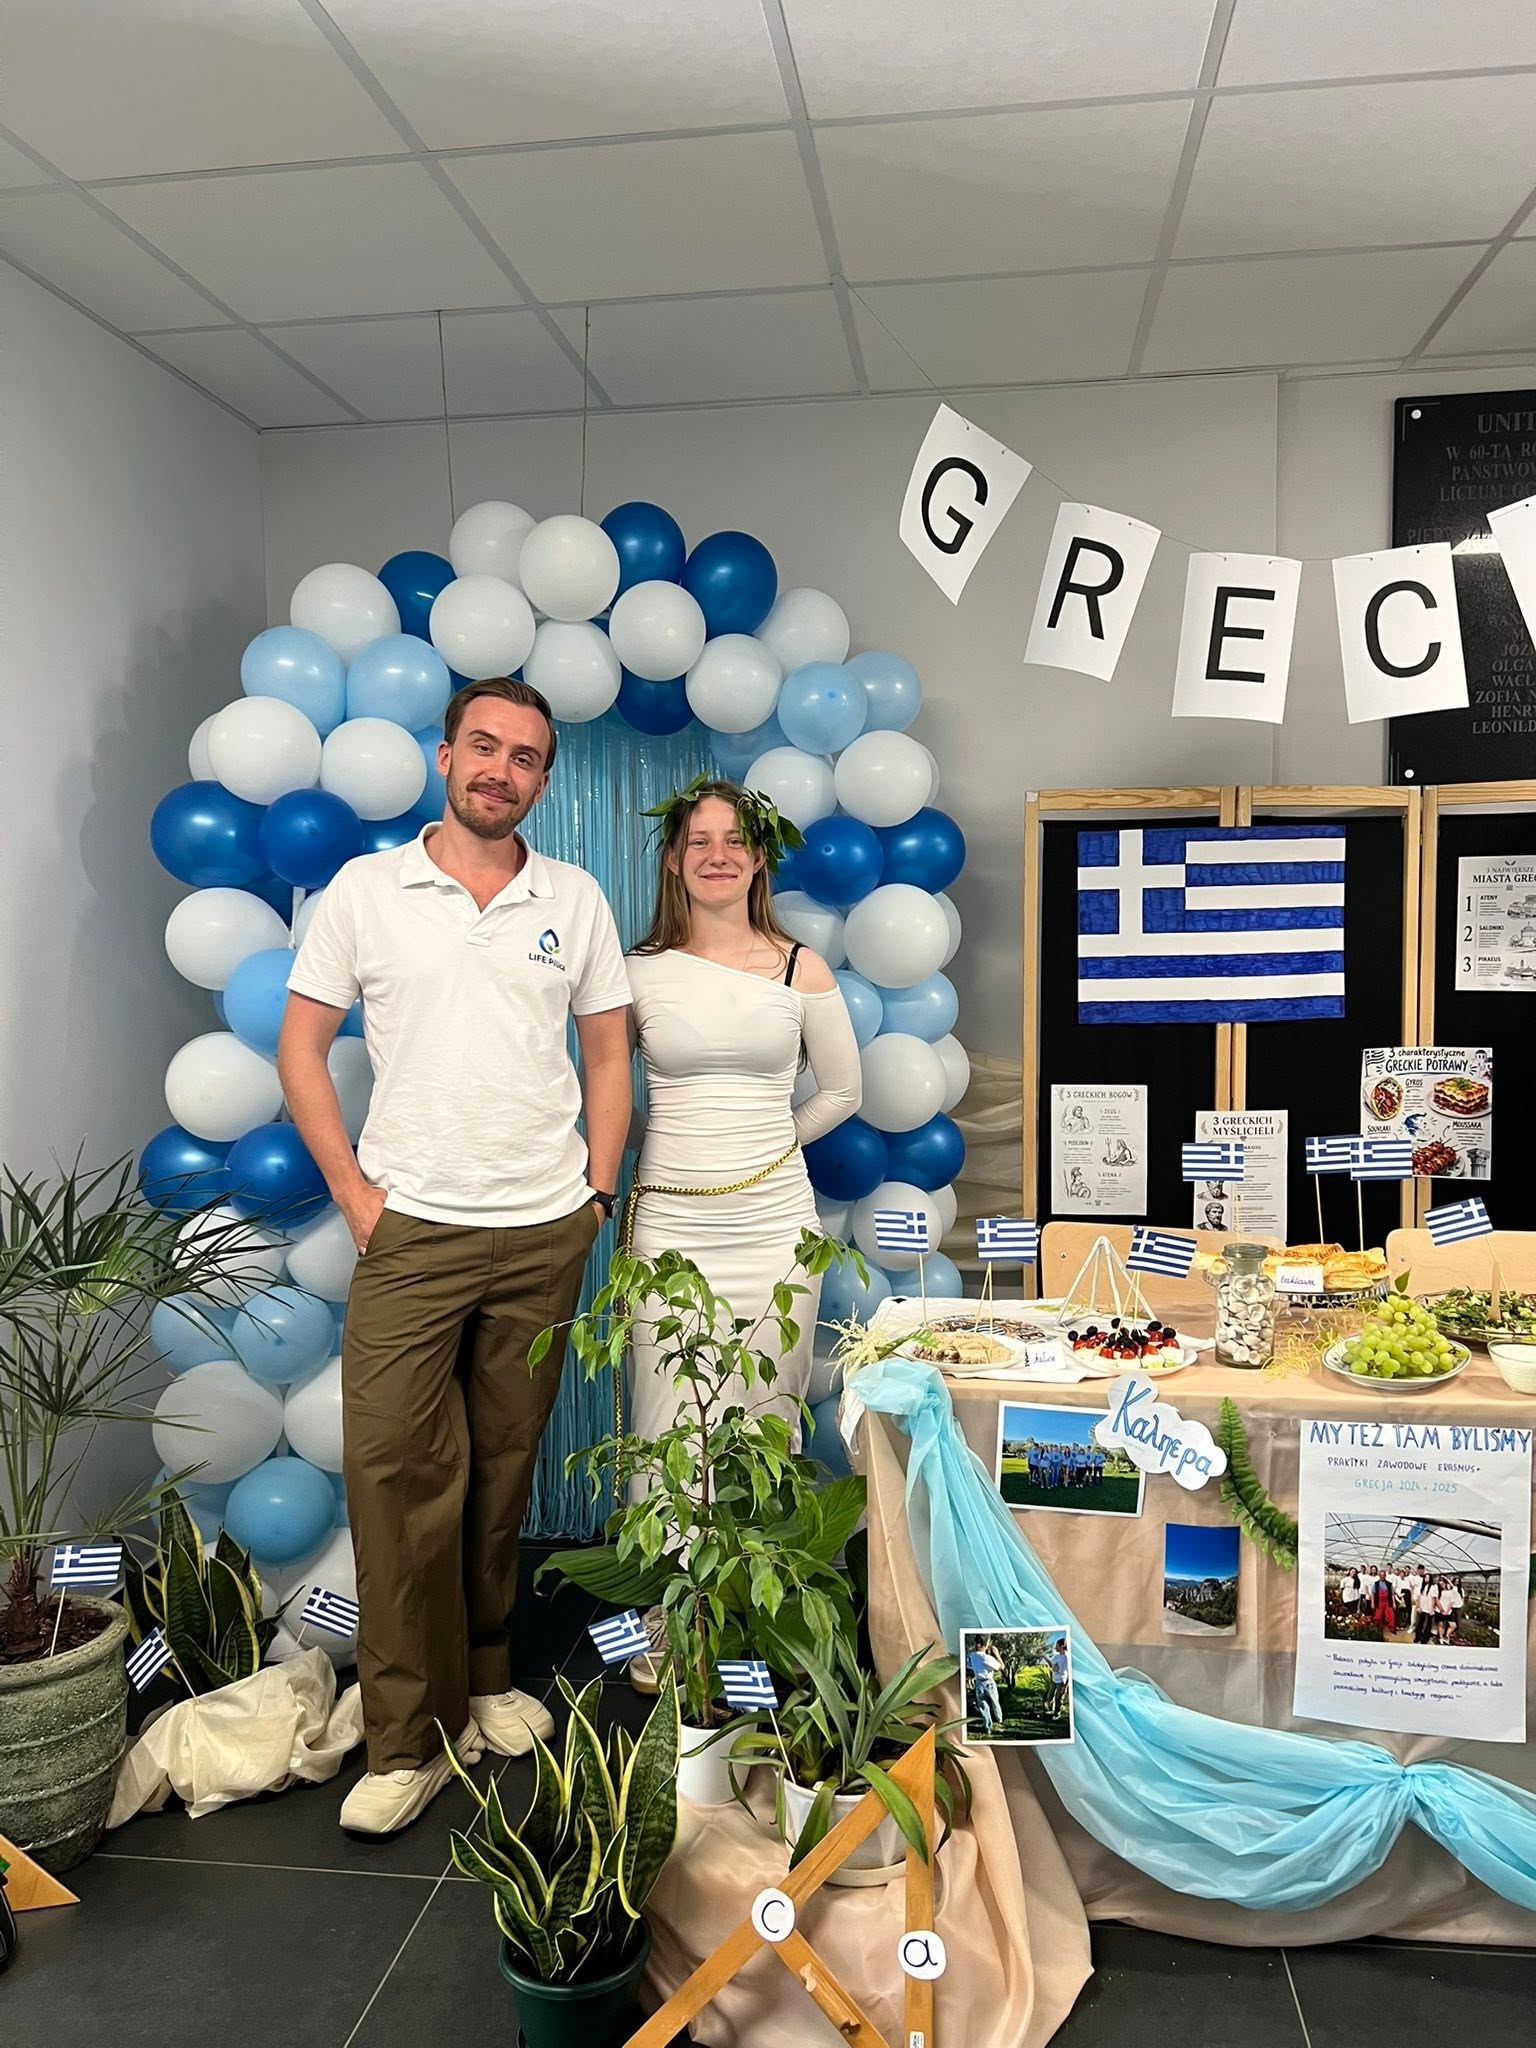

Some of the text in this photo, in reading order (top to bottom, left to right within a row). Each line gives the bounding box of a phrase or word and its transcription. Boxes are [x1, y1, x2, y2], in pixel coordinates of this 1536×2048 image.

[1492, 659, 1535, 672] OLGA
[1475, 690, 1521, 703] ZOFIA
[1473, 874, 1536, 883] MIASTA GRE
[1466, 895, 1472, 912] 1
[1463, 925, 1473, 942] 2
[528, 952, 547, 964] LIFE
[1463, 956, 1472, 972] 3
[1389, 1048, 1466, 1059] 3 charakterystyczne
[1385, 1058, 1469, 1074] GRECKIE POTRAWY
[1405, 1078, 1424, 1087] GYROS
[1066, 1090, 1072, 1099] 3
[1073, 1090, 1107, 1099] GRECKICH
[1213, 1116, 1273, 1125] 3 GRECKICH
[1213, 1126, 1274, 1136] MYŚLICIELI
[1309, 1421, 1343, 1445] MY
[1347, 1422, 1384, 1447] TEŻ
[1392, 1424, 1441, 1450] TAM
[1327, 1456, 1368, 1468] PRAKTYKI
[1377, 1459, 1428, 1471] ZAWODOWE
[1354, 1479, 1393, 1491] GRECJA
[1432, 1482, 1457, 1493] 2025
[903, 1938, 938, 1968] a
